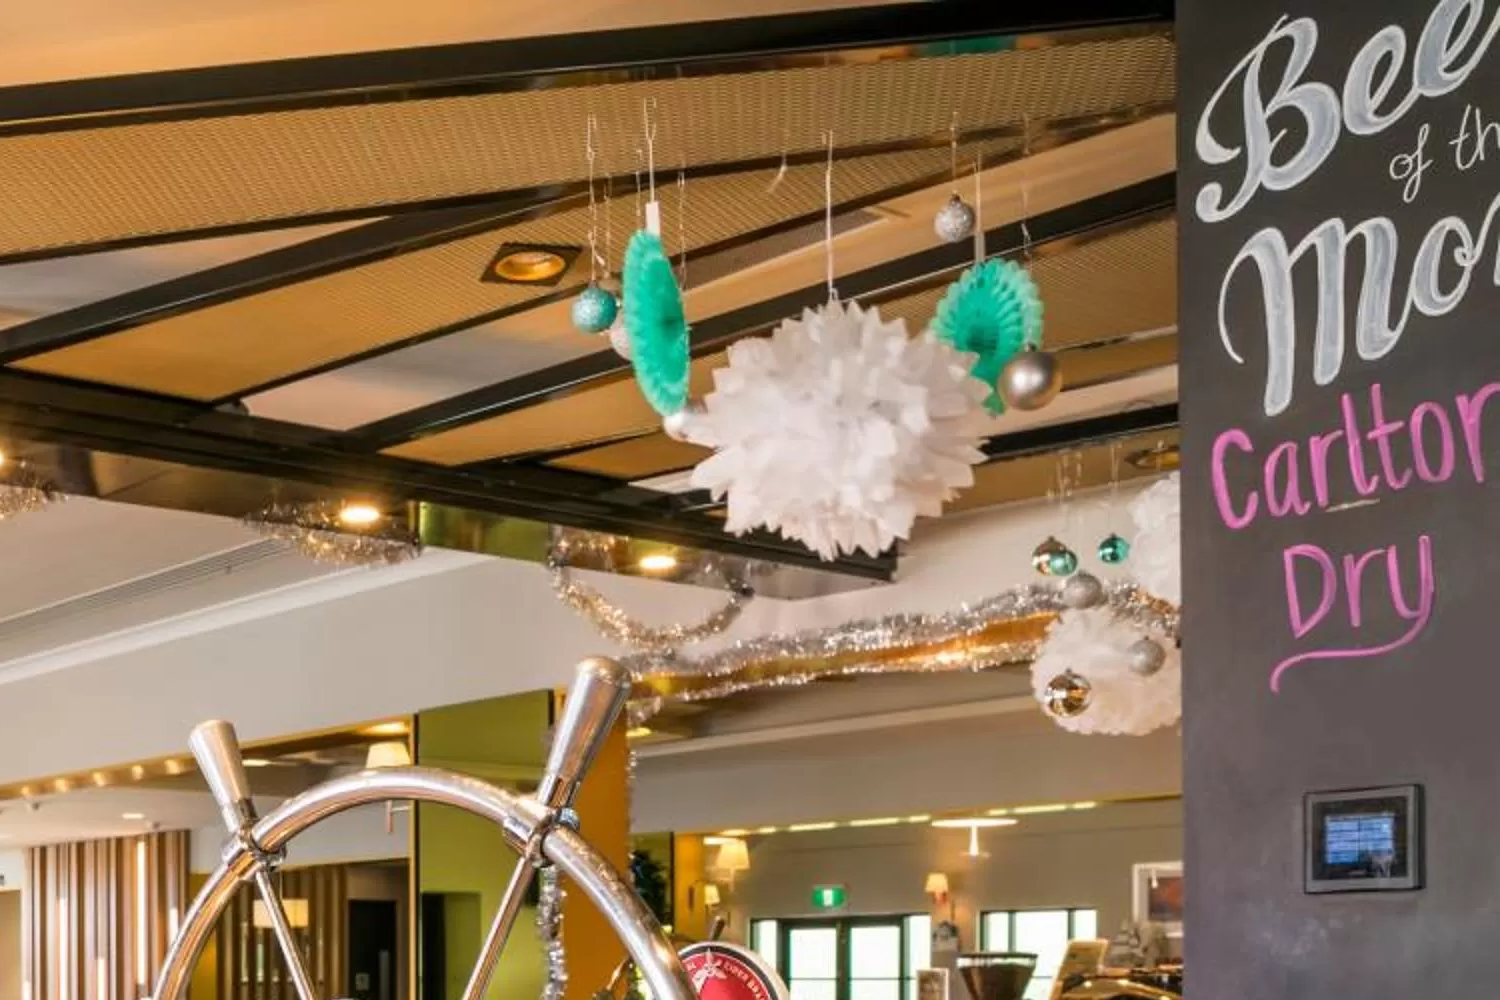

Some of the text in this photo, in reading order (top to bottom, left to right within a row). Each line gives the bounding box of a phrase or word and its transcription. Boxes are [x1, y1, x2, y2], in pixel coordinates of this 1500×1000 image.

[1389, 122, 1434, 203] of
[1218, 192, 1500, 417] Mo
[1269, 534, 1435, 693] Dry
